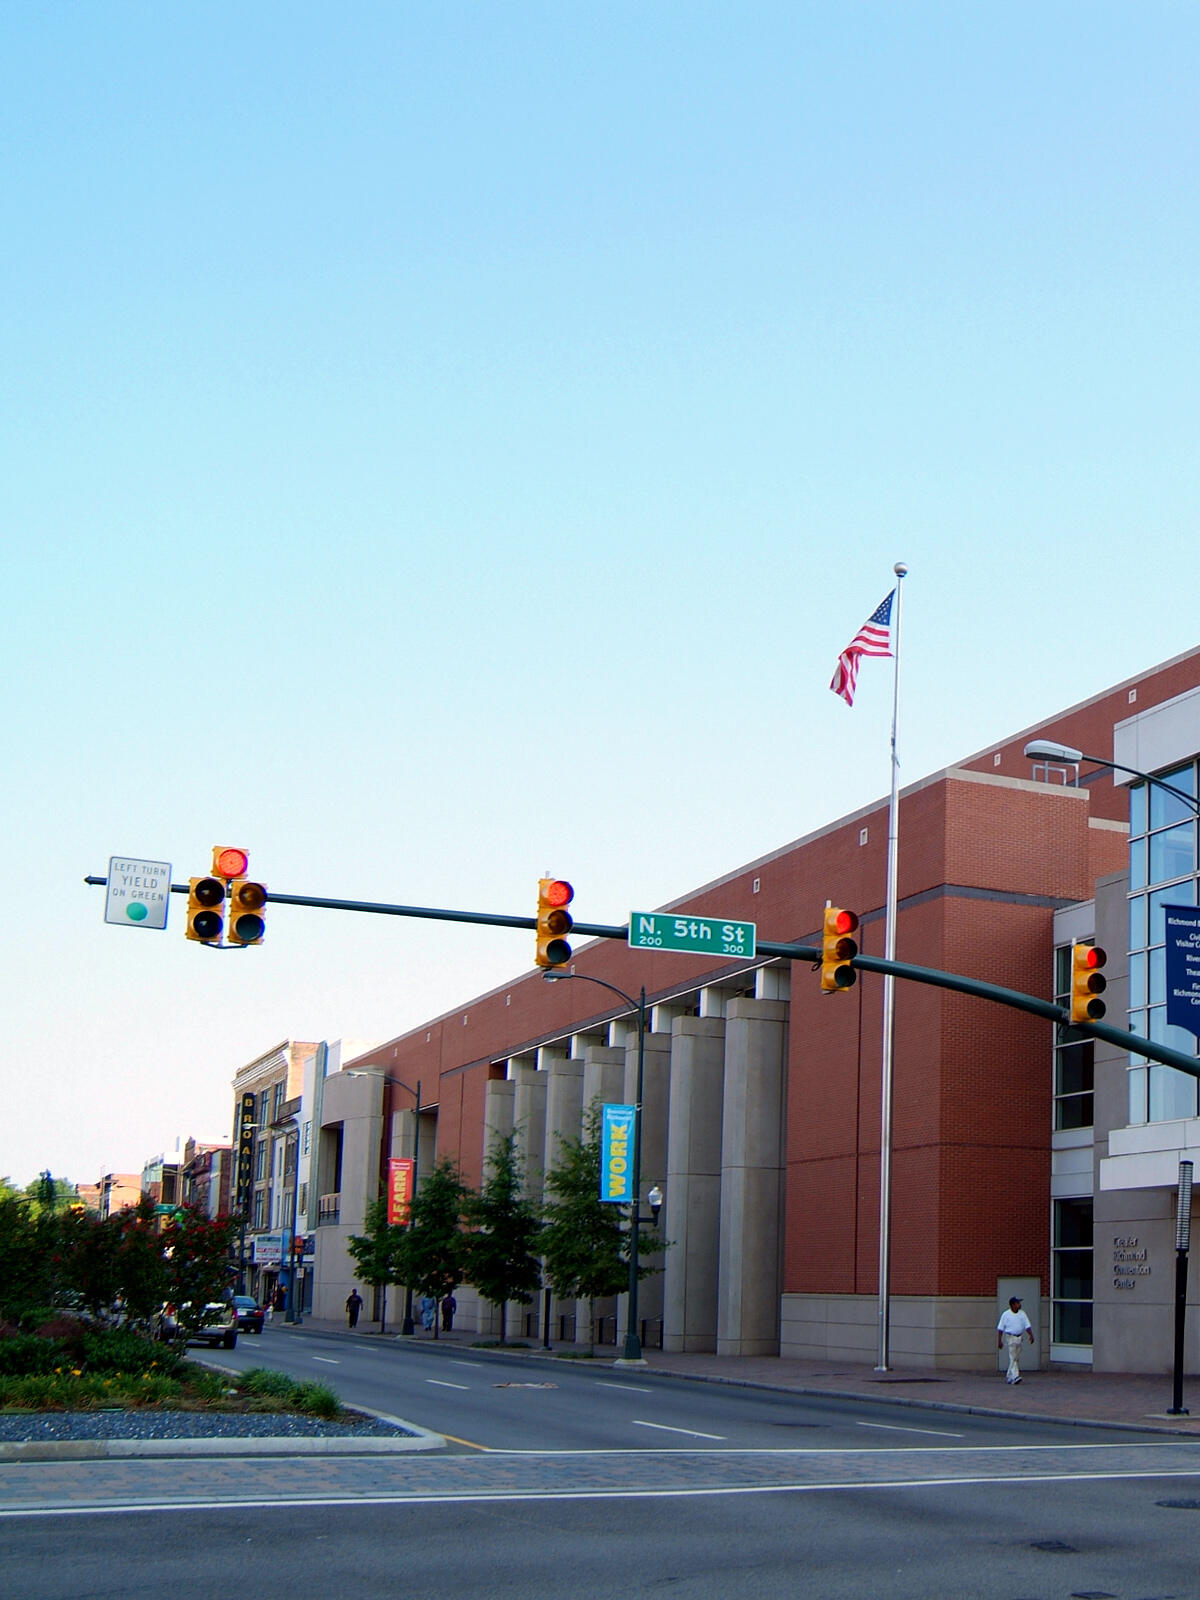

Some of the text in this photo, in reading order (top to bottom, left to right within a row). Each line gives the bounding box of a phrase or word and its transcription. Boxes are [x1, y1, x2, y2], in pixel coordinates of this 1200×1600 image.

[114, 863, 166, 876] LEFT TURN
[122, 875, 158, 889] YIELD
[112, 888, 164, 901] ON GREEN
[1167, 917, 1197, 927] Richmond
[639, 916, 745, 943] N. 5th St
[639, 935, 662, 946] 200
[1175, 939, 1195, 948] Visitor
[722, 943, 744, 954] 300
[609, 1123, 628, 1198] WORK
[392, 1170, 407, 1223] LEARN
